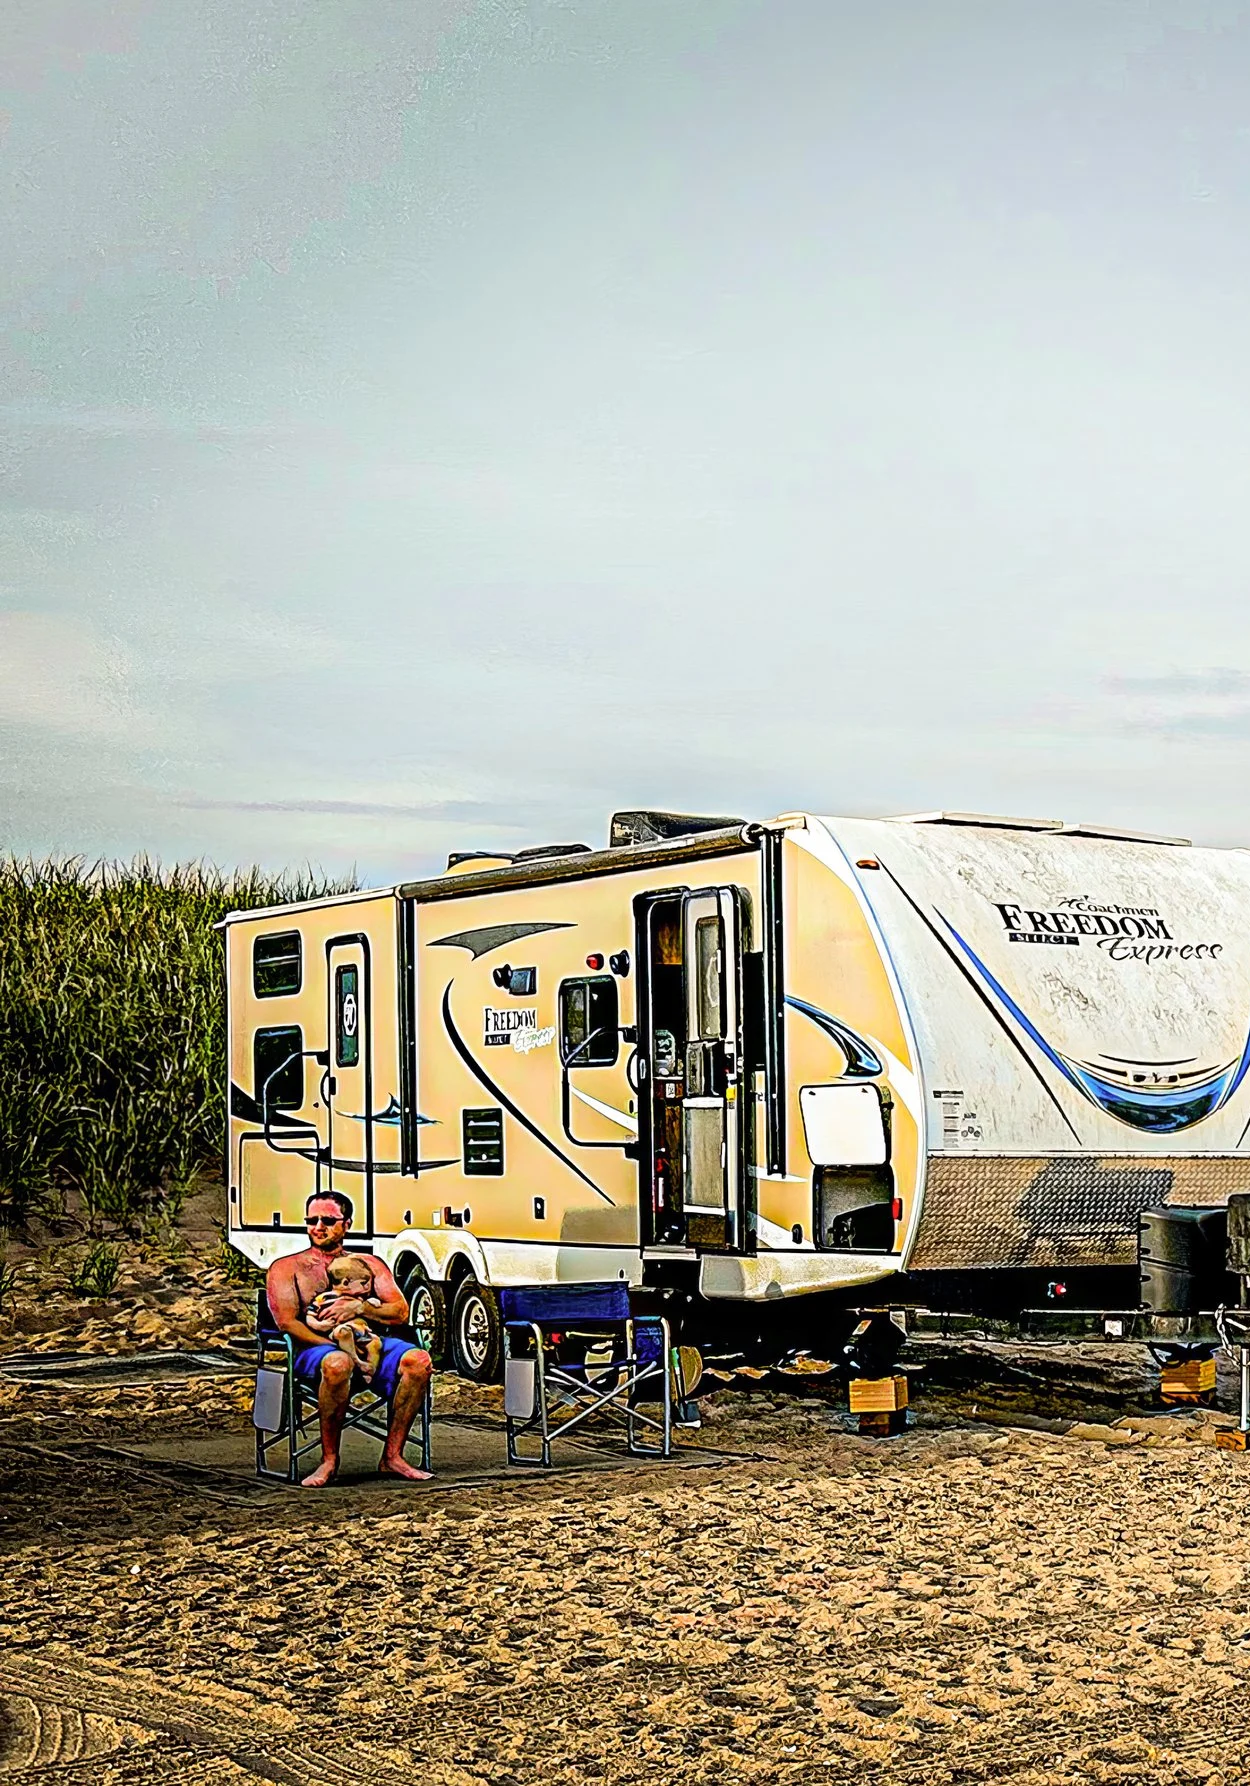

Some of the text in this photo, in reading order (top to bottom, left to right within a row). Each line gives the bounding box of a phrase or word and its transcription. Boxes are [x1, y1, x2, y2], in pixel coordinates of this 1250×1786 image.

[991, 903, 1174, 940] FREEDOM
[1075, 902, 1160, 917] Coachmen
[1096, 936, 1223, 966] Express
[484, 1007, 537, 1032] FREEDOM
